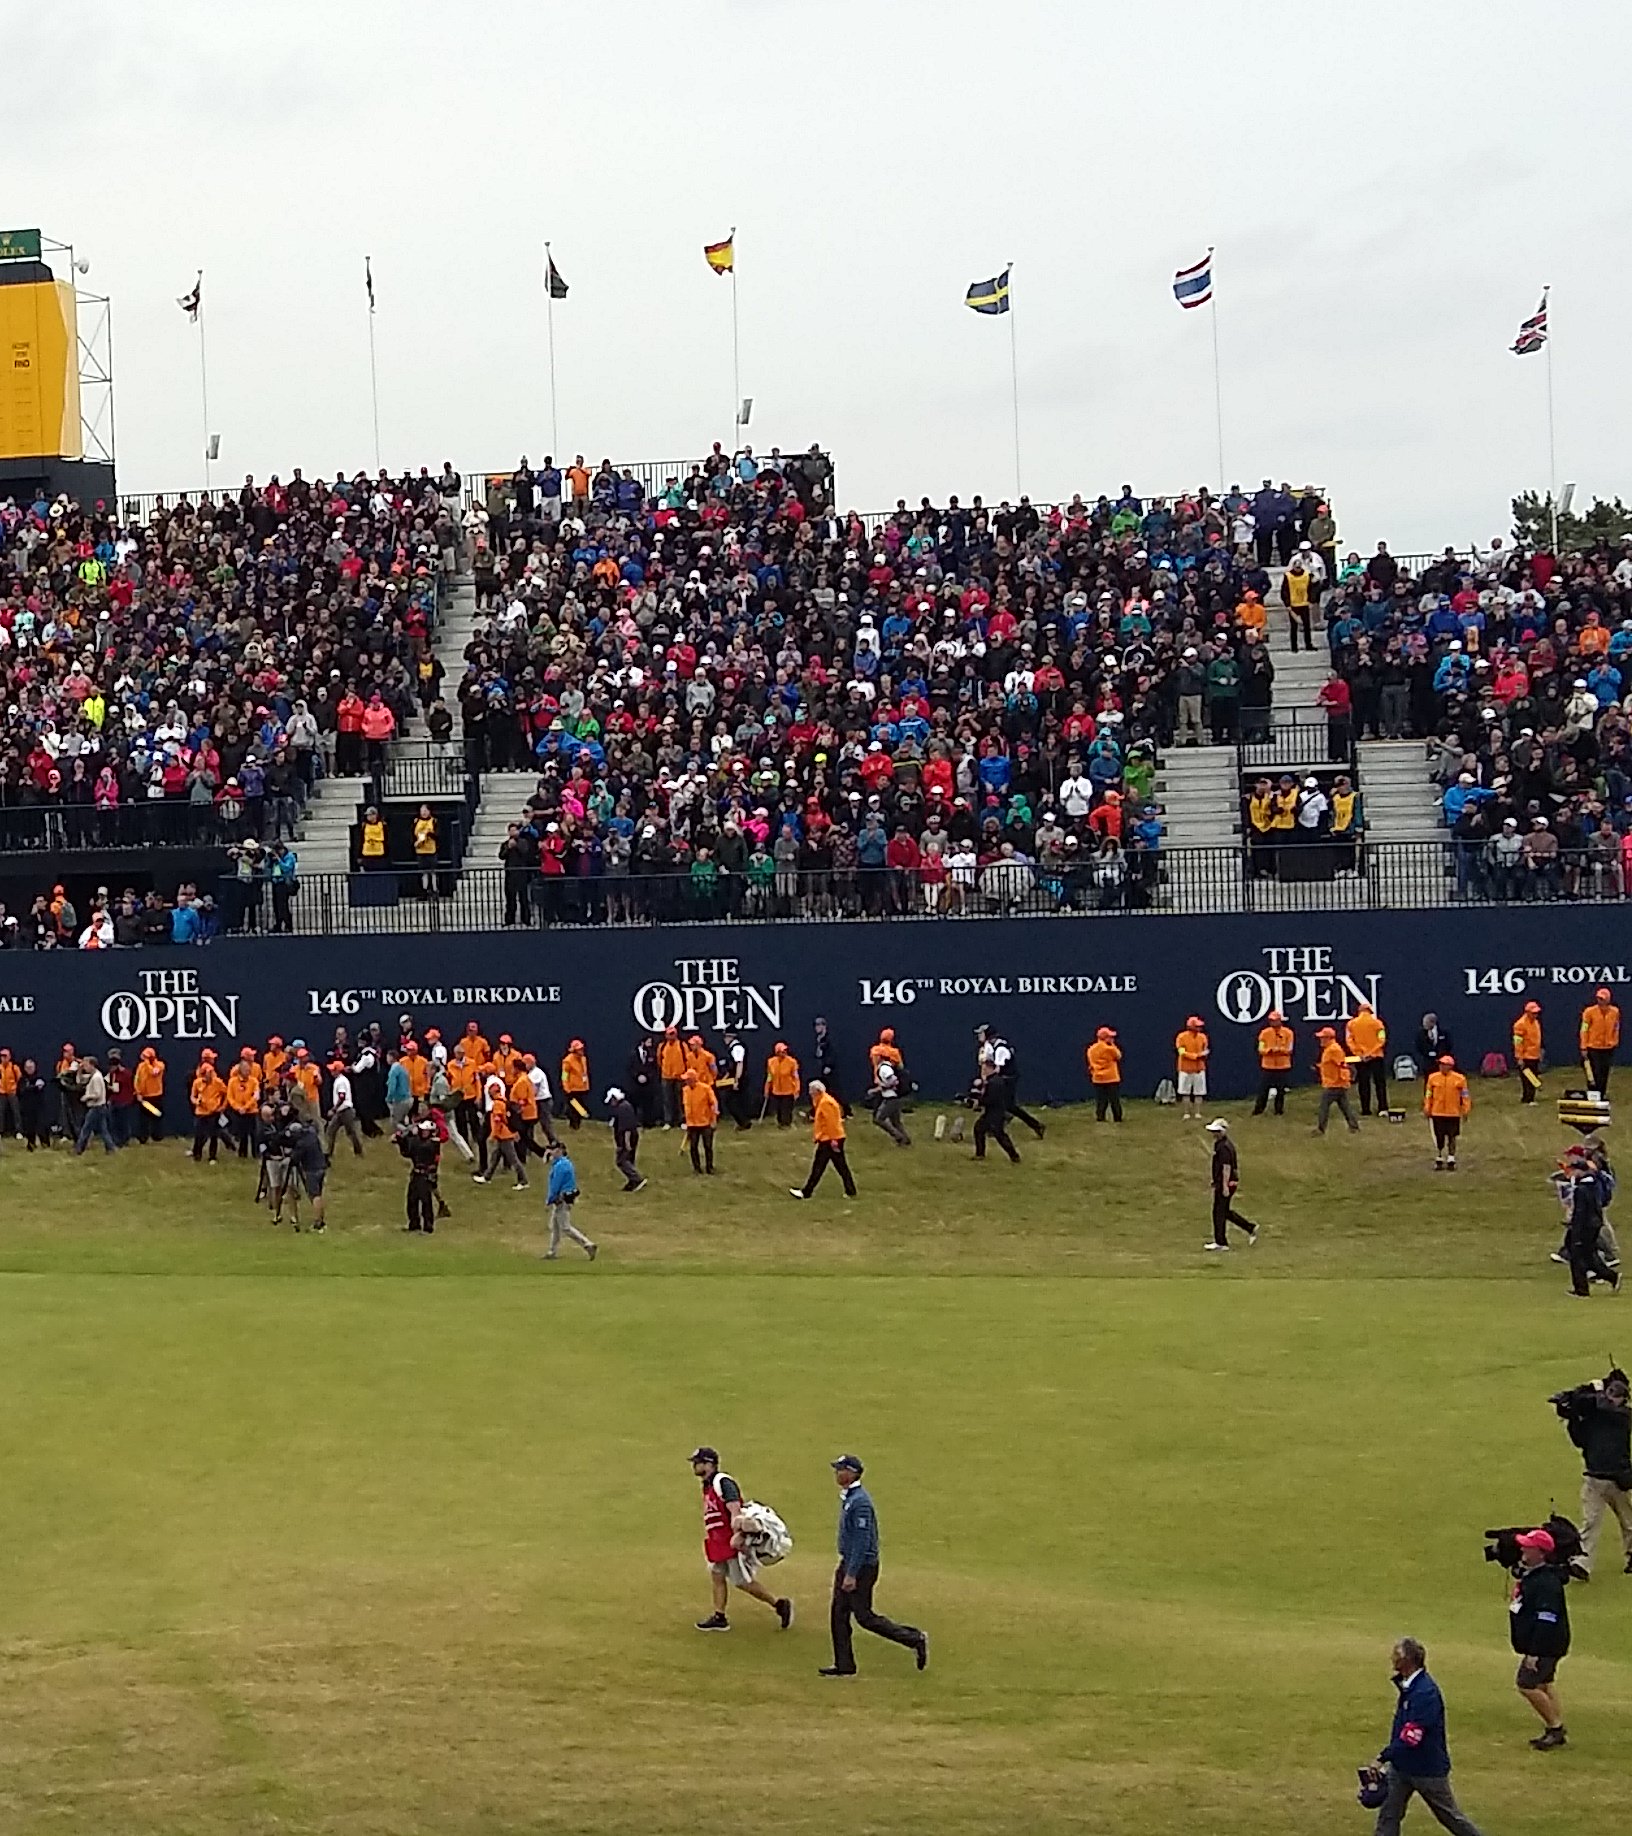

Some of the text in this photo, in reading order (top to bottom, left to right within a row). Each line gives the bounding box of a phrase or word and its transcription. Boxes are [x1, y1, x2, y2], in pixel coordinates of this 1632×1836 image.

[674, 958, 740, 985] THE
[1262, 946, 1334, 974] THE
[138, 969, 199, 995] THE
[858, 975, 1137, 1005] 146TH ROYAL BIRKDALE
[1464, 966, 1631, 995] 146TH ROYAL
[307, 986, 561, 1015] 146TH ROYAL BIRKDALE
[633, 981, 784, 1032] OPEN
[1217, 970, 1382, 1023] OPEN
[101, 991, 240, 1040] OPEN
